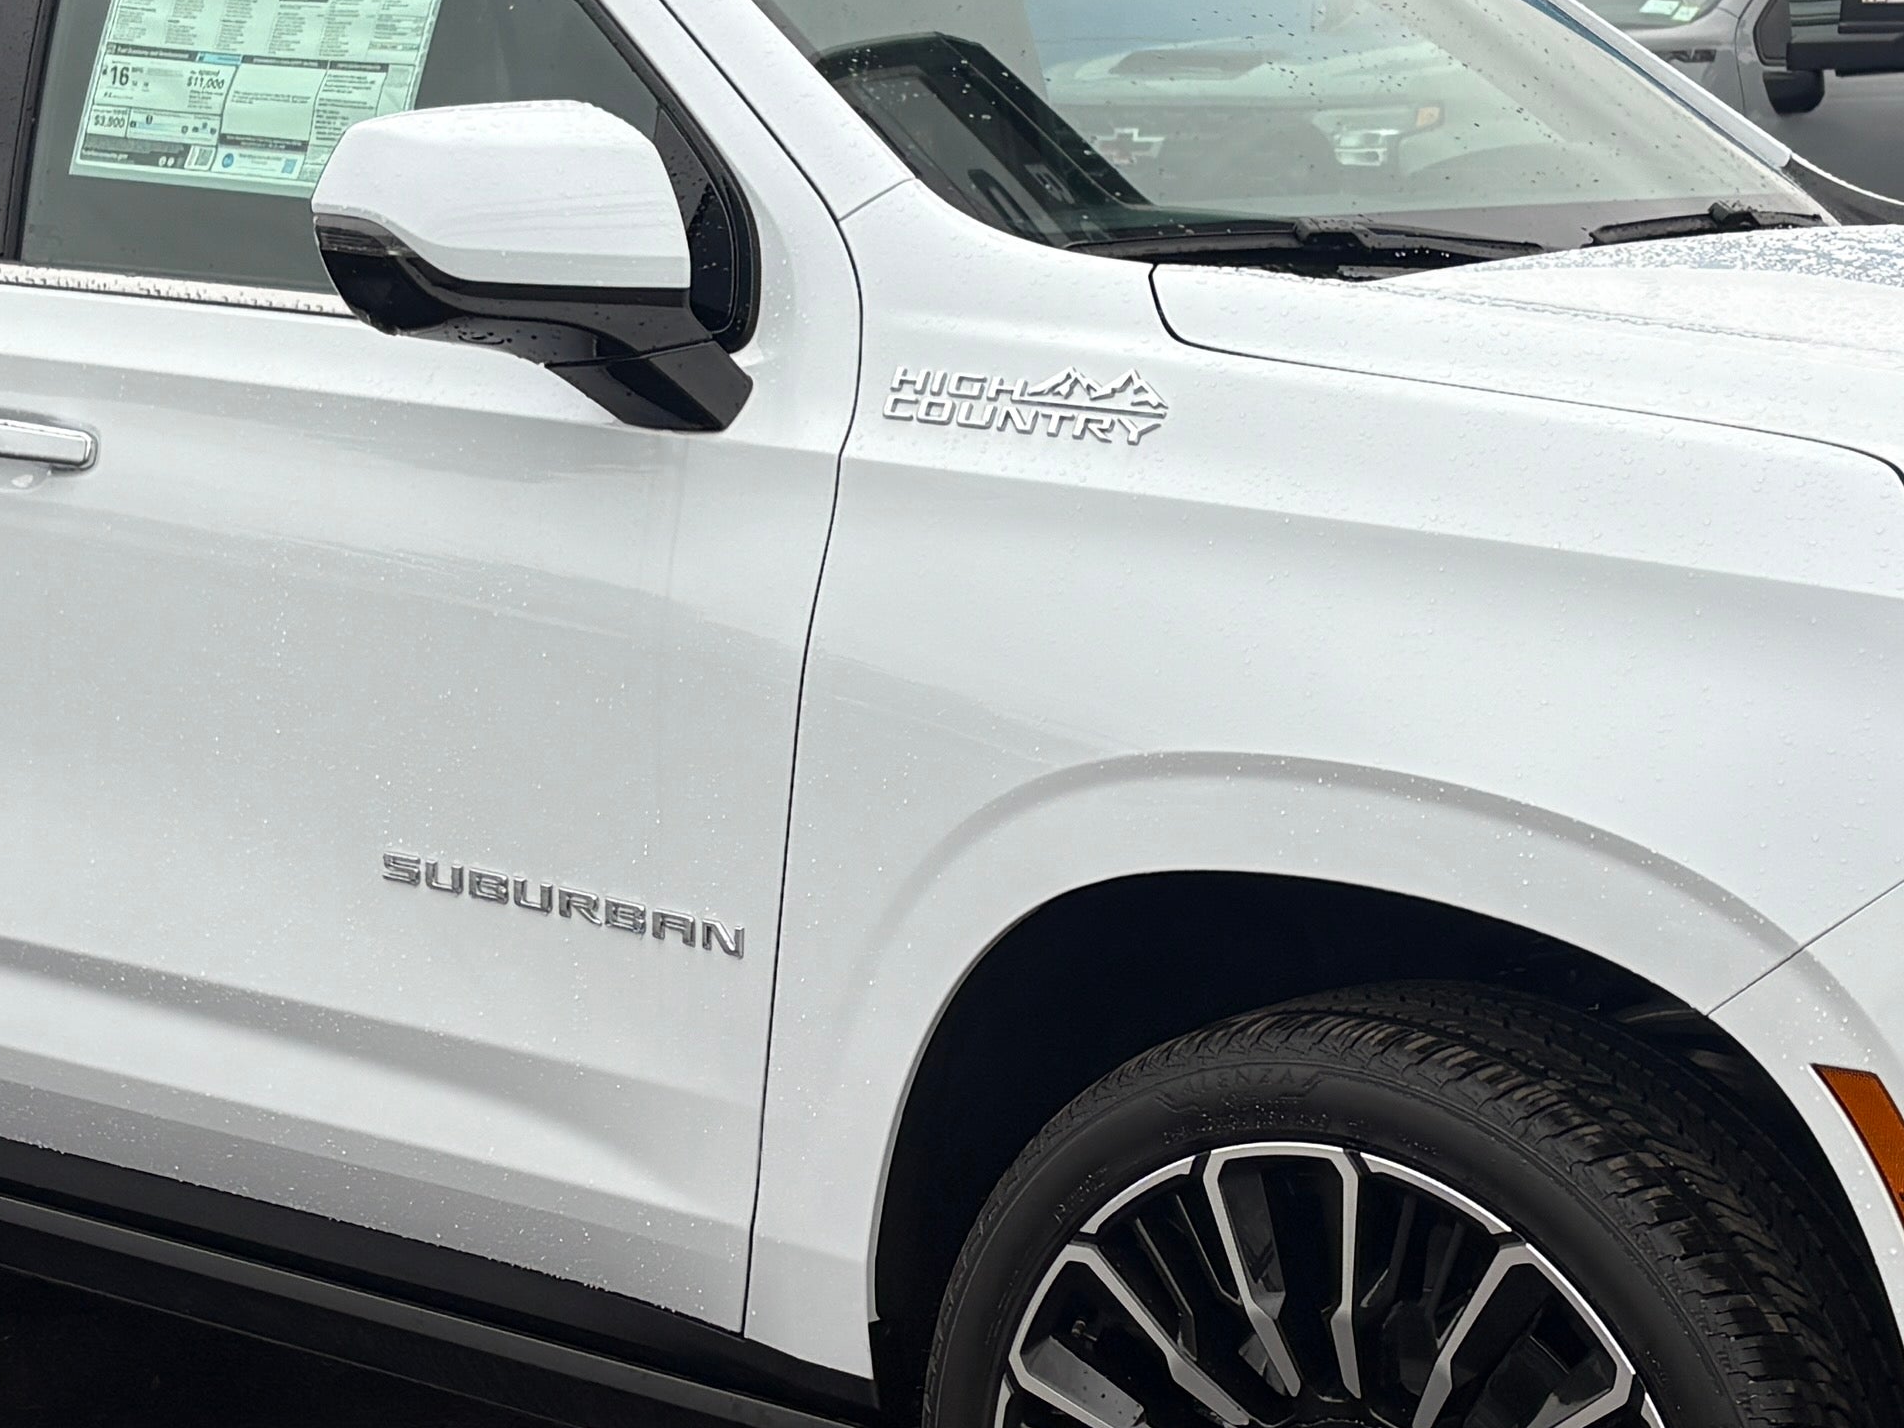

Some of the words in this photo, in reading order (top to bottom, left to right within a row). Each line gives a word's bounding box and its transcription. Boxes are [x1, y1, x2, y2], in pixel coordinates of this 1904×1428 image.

[110, 65, 130, 86] 16
[890, 365, 1028, 402] HIGH
[882, 394, 1162, 446] COUNTRY
[381, 850, 746, 961] SUBURBAN
